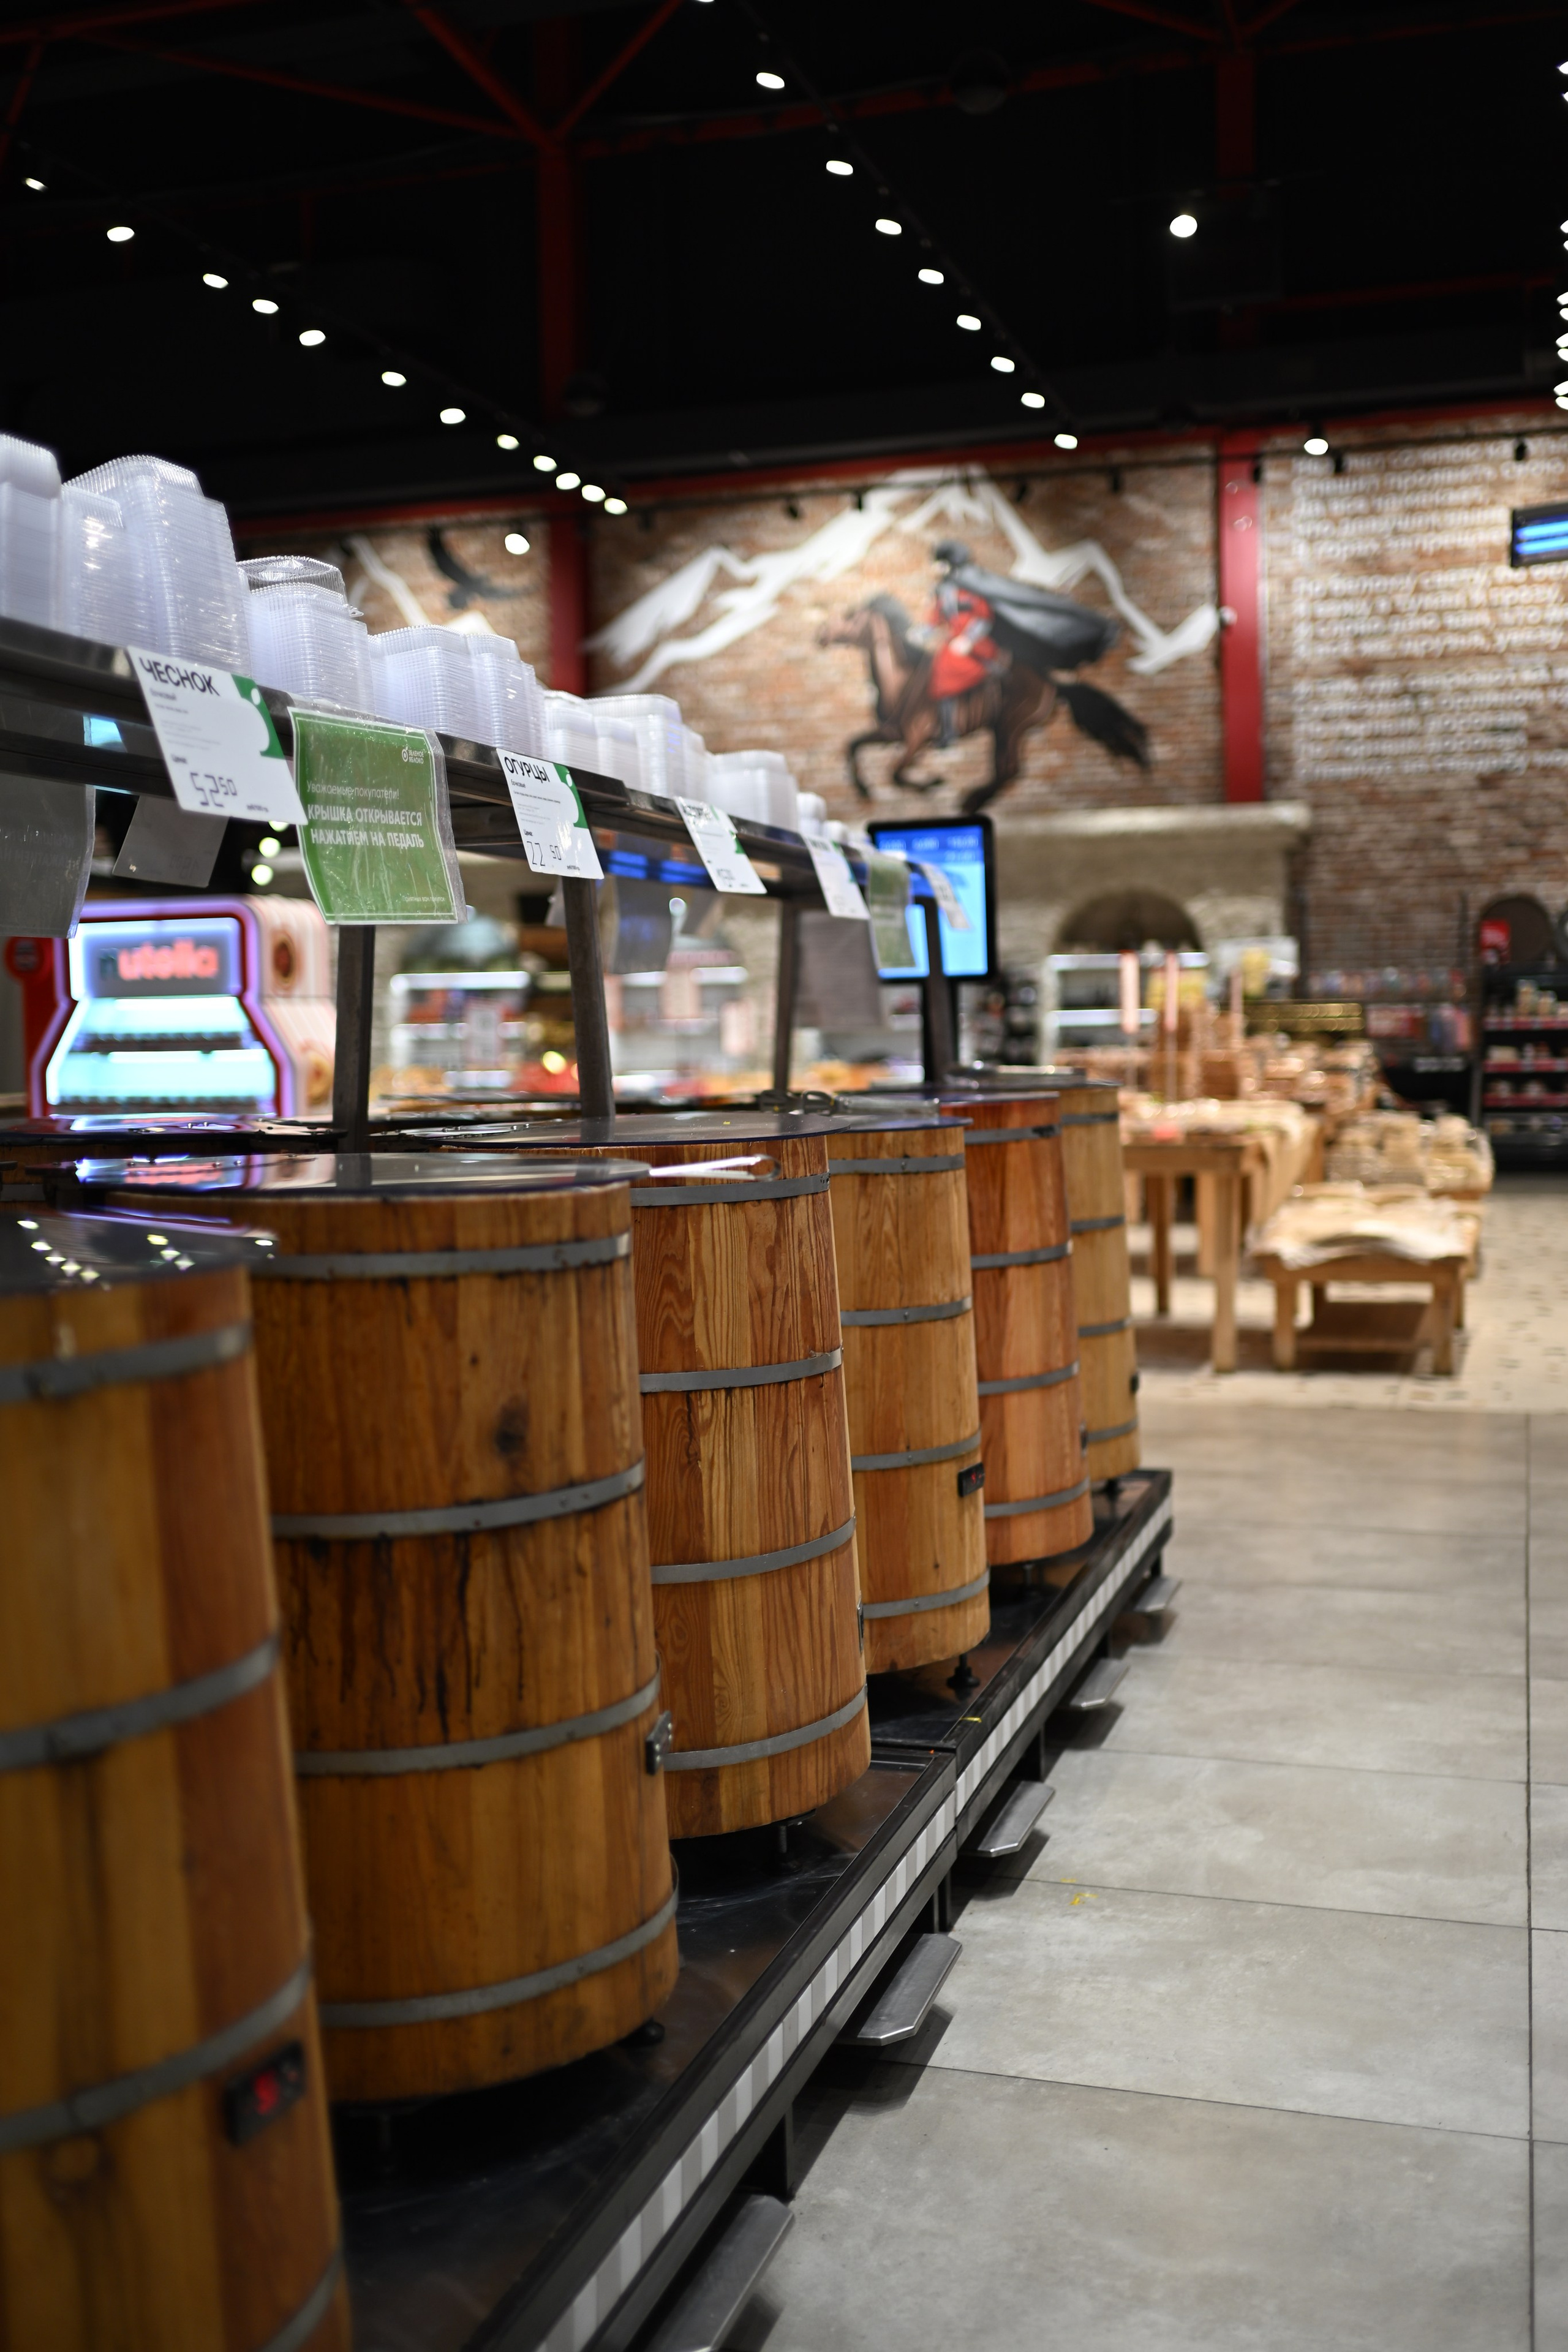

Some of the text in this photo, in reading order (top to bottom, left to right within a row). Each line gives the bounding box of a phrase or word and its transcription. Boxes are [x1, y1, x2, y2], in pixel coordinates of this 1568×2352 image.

[139, 657, 220, 696] ЧЕСНОК
[504, 756, 550, 783] ОГУРЦЫ
[307, 780, 399, 802] Уважаемые покупатели!
[307, 804, 423, 826] КРЫШКА ОТКРЫВАЕТСЯ
[311, 829, 424, 848] НАЖАТИЕМ НА ПЕДАЛЬ
[99, 938, 220, 981] nutella
